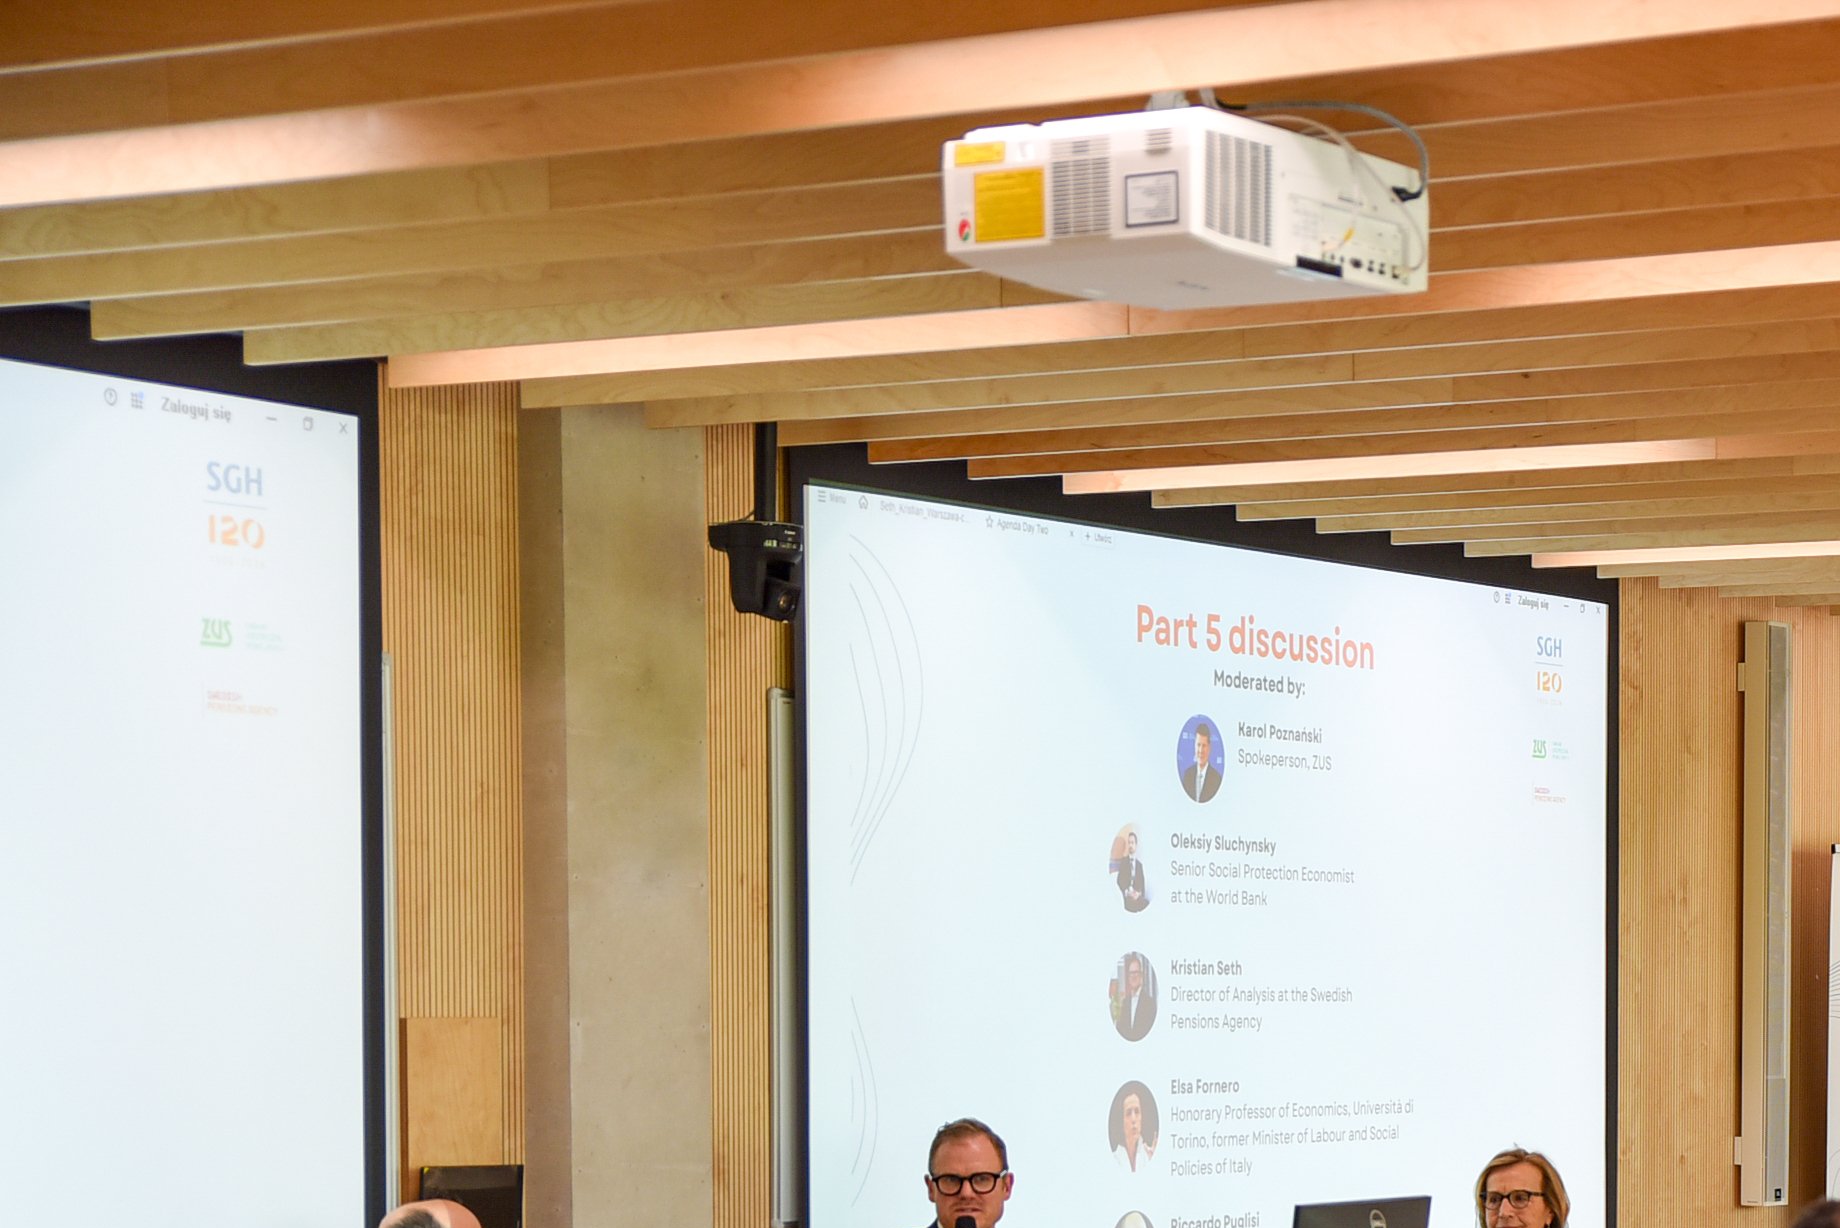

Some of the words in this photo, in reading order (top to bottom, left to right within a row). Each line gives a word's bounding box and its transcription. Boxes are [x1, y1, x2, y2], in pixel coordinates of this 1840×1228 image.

[206, 461, 264, 496] SGH
[1022, 521, 1035, 535] Day
[200, 617, 232, 648] ZUS
[1137, 604, 1198, 649] Part
[1206, 613, 1222, 652] 5
[1229, 614, 1375, 670] discussion
[1537, 636, 1562, 658] SGH
[1213, 669, 1284, 694] Moderated
[1287, 676, 1306, 699] by:
[1238, 721, 1266, 739] Karol
[1269, 725, 1322, 744] Poznański
[1238, 749, 1310, 770] Spokeperson,
[1312, 755, 1332, 771] ZUS
[1171, 833, 1212, 853] Oleksiy
[1214, 835, 1276, 856] Sluchynsky
[1171, 860, 1206, 877] Senior
[1208, 862, 1241, 878] Social
[1244, 863, 1299, 881] Protection
[1301, 867, 1355, 884] Economist
[1170, 890, 1182, 904] at
[1185, 889, 1203, 904] the
[1206, 889, 1238, 905] World
[1241, 890, 1268, 906] Bank
[1171, 959, 1214, 976] Kristian
[1217, 960, 1242, 976] Seth
[1171, 986, 1216, 1002] Director
[1219, 986, 1231, 1002] of
[1233, 987, 1276, 1005] Analysis
[1278, 988, 1289, 1002] at
[1290, 987, 1308, 1002] the
[1310, 987, 1353, 1003] Swedish
[1171, 1013, 1220, 1029] Pensions
[1222, 1014, 1262, 1033] Agency
[1171, 1079, 1193, 1095] Elsa
[1196, 1079, 1240, 1095] Fornero
[1171, 1104, 1222, 1124] Honorary
[1225, 1103, 1276, 1120] Professor
[1278, 1101, 1290, 1118] of
[1292, 1101, 1351, 1118] Economics,
[1405, 1099, 1414, 1114] di
[1171, 1133, 1210, 1150] Torino,
[1212, 1130, 1250, 1147] former
[1252, 1128, 1294, 1146] Minister
[1297, 1128, 1308, 1144] of
[1311, 1127, 1346, 1143] Labour
[1348, 1126, 1368, 1141] and
[1370, 1125, 1400, 1141] Social
[1171, 1160, 1213, 1177] Policies
[1215, 1159, 1227, 1174] of
[1229, 1158, 1253, 1177] Italy
